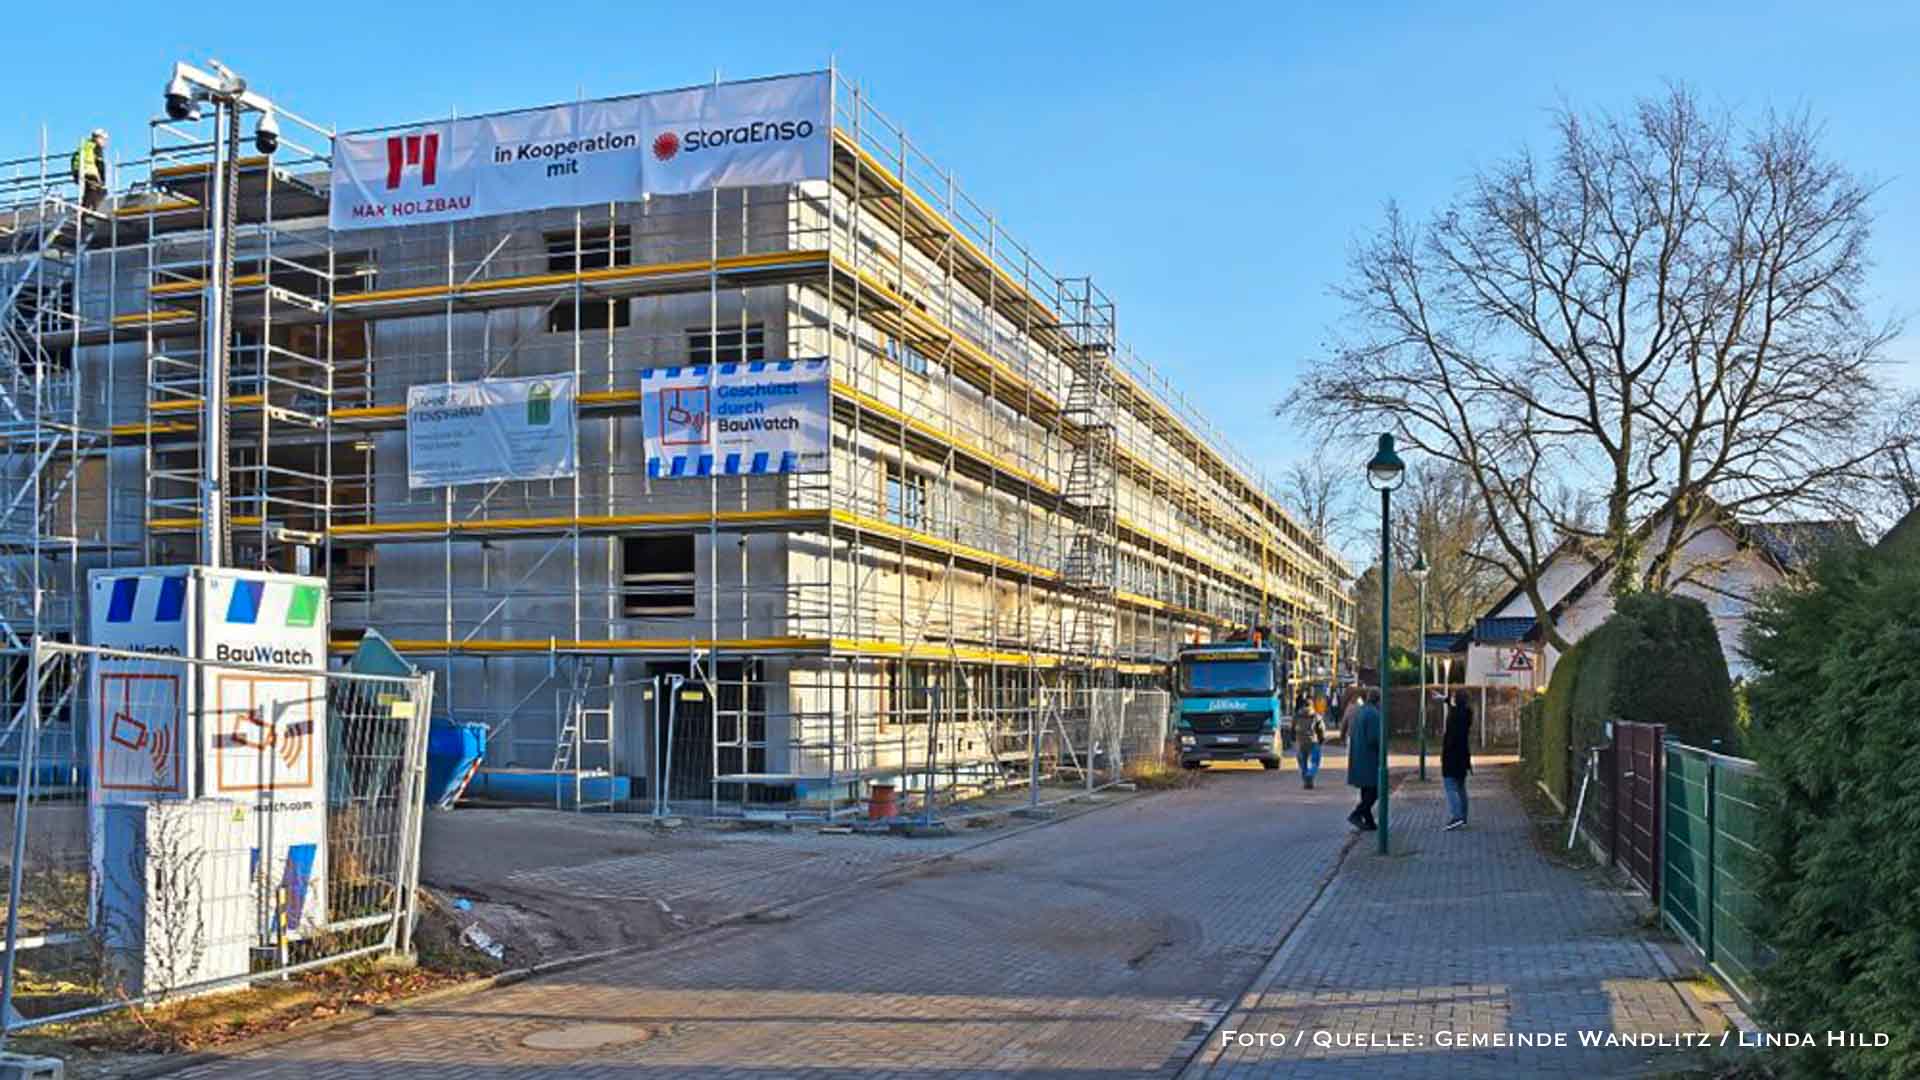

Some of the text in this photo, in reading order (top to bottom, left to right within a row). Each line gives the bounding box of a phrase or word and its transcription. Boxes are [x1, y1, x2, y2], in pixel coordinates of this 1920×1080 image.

[684, 120, 814, 152] StoraEnso
[494, 132, 636, 163] in Kooperation
[546, 158, 579, 177] mit
[352, 195, 471, 218] MAX HOLZBAU
[717, 381, 799, 399] Geschützt
[717, 401, 764, 416] durch
[718, 416, 799, 433] BauWatch
[216, 644, 313, 665] BauWatch
